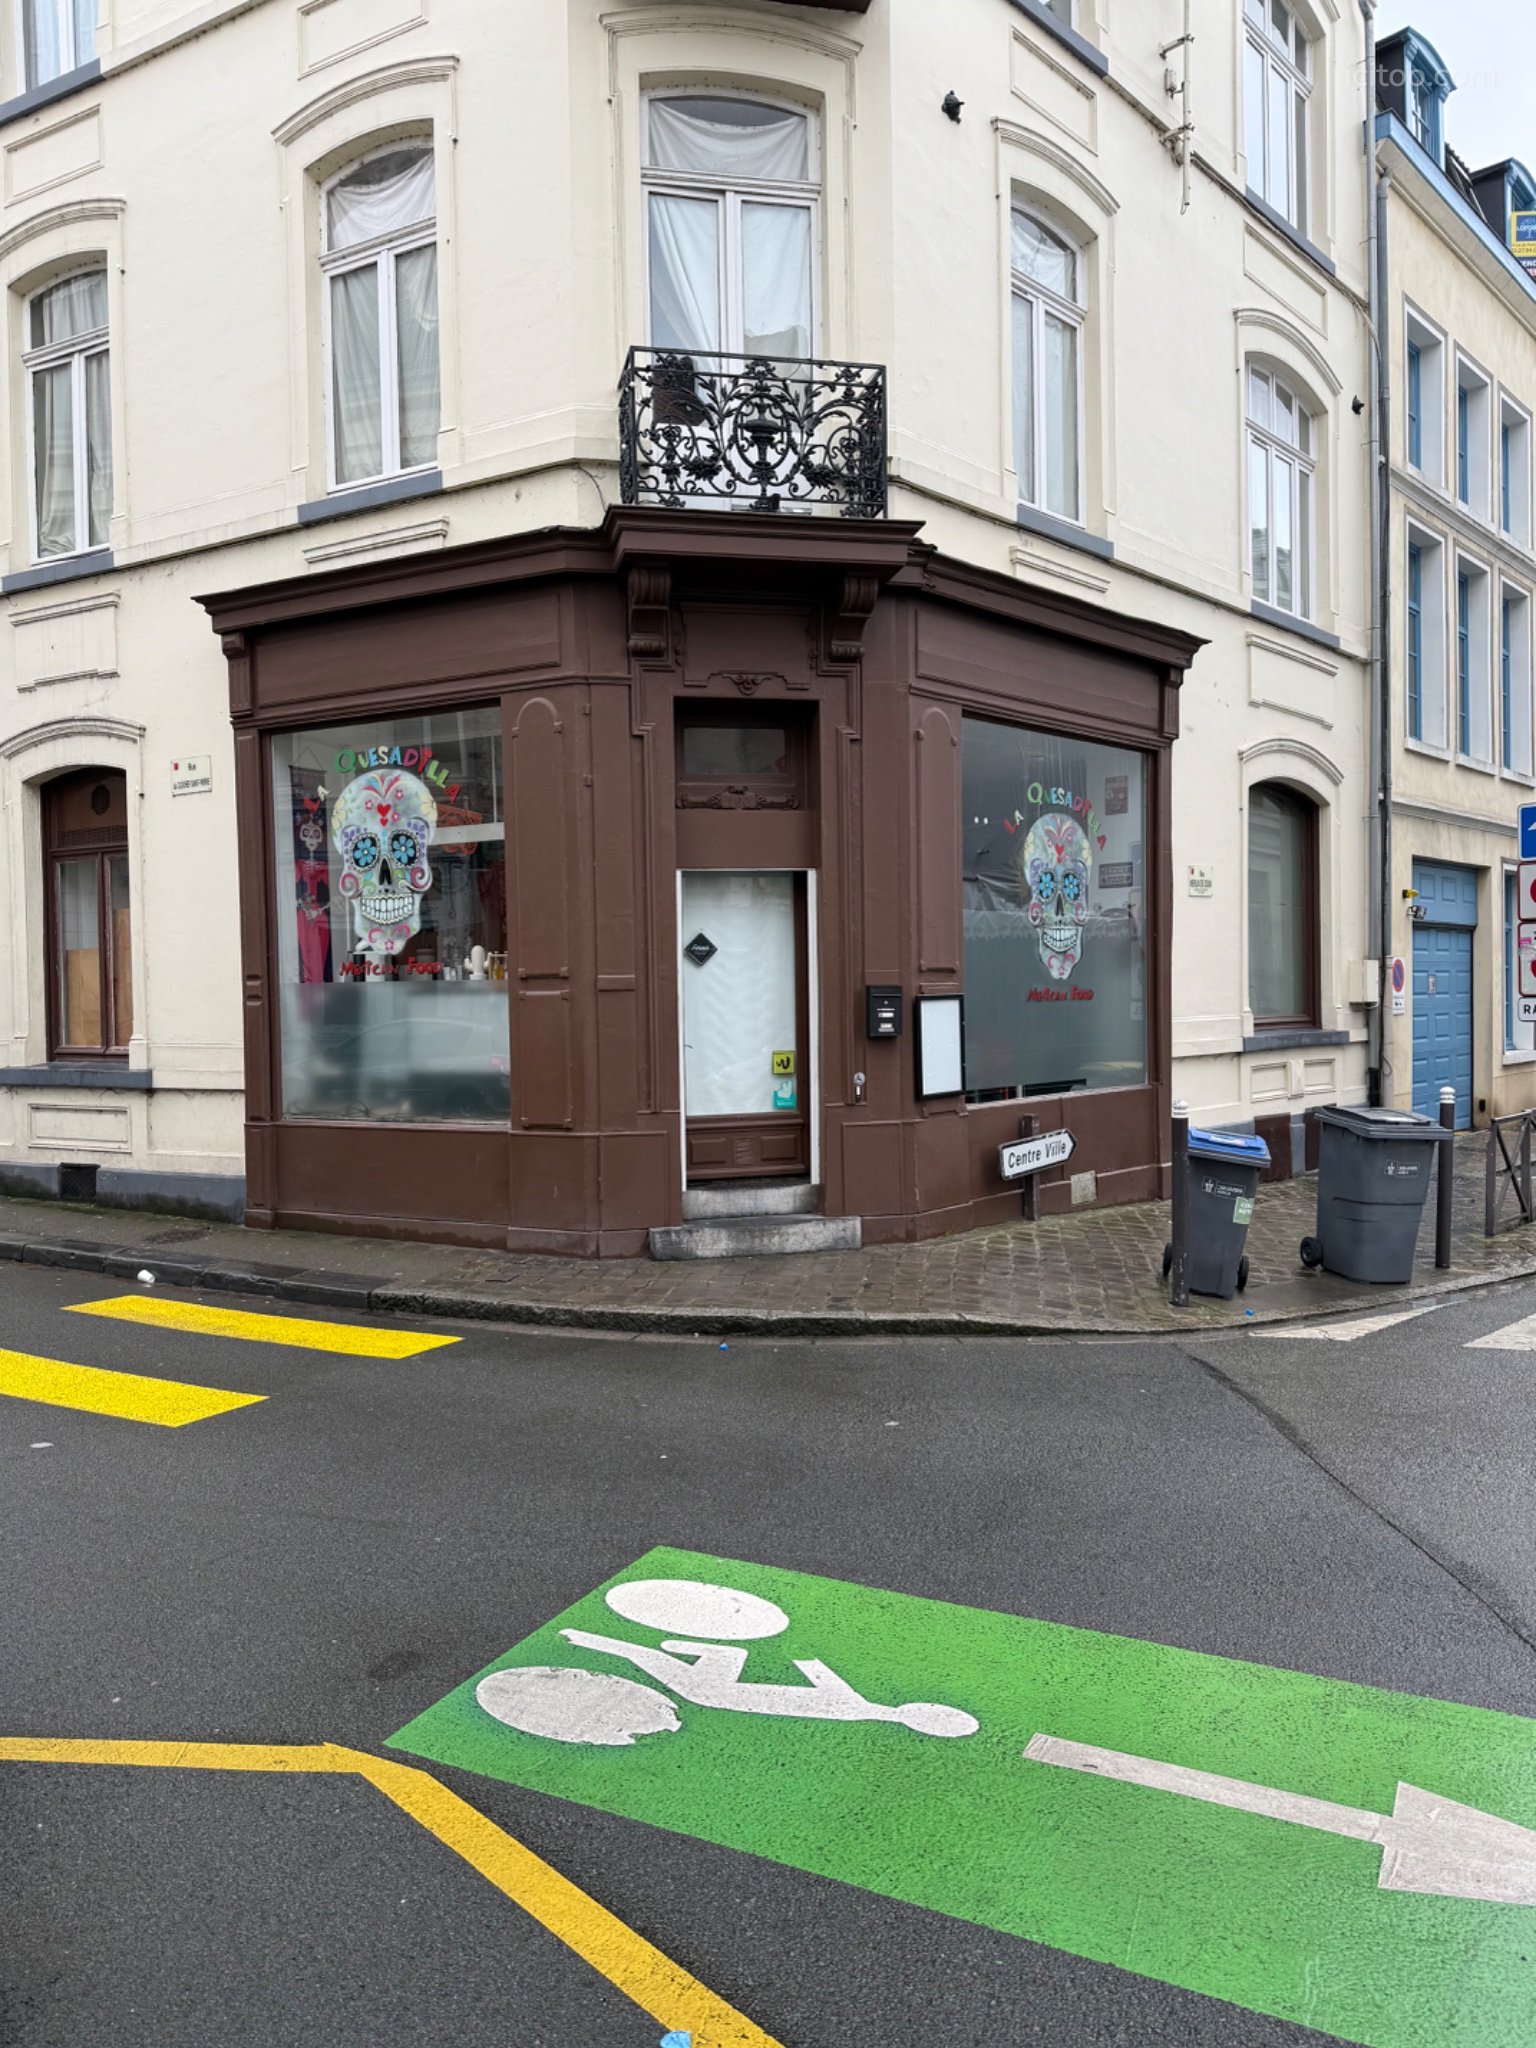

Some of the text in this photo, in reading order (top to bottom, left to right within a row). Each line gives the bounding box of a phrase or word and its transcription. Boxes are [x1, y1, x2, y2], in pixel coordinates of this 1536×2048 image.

[303, 784, 331, 815] LA
[1003, 809, 1025, 836] LA
[1008, 1140, 1067, 1169] Centre Ville
